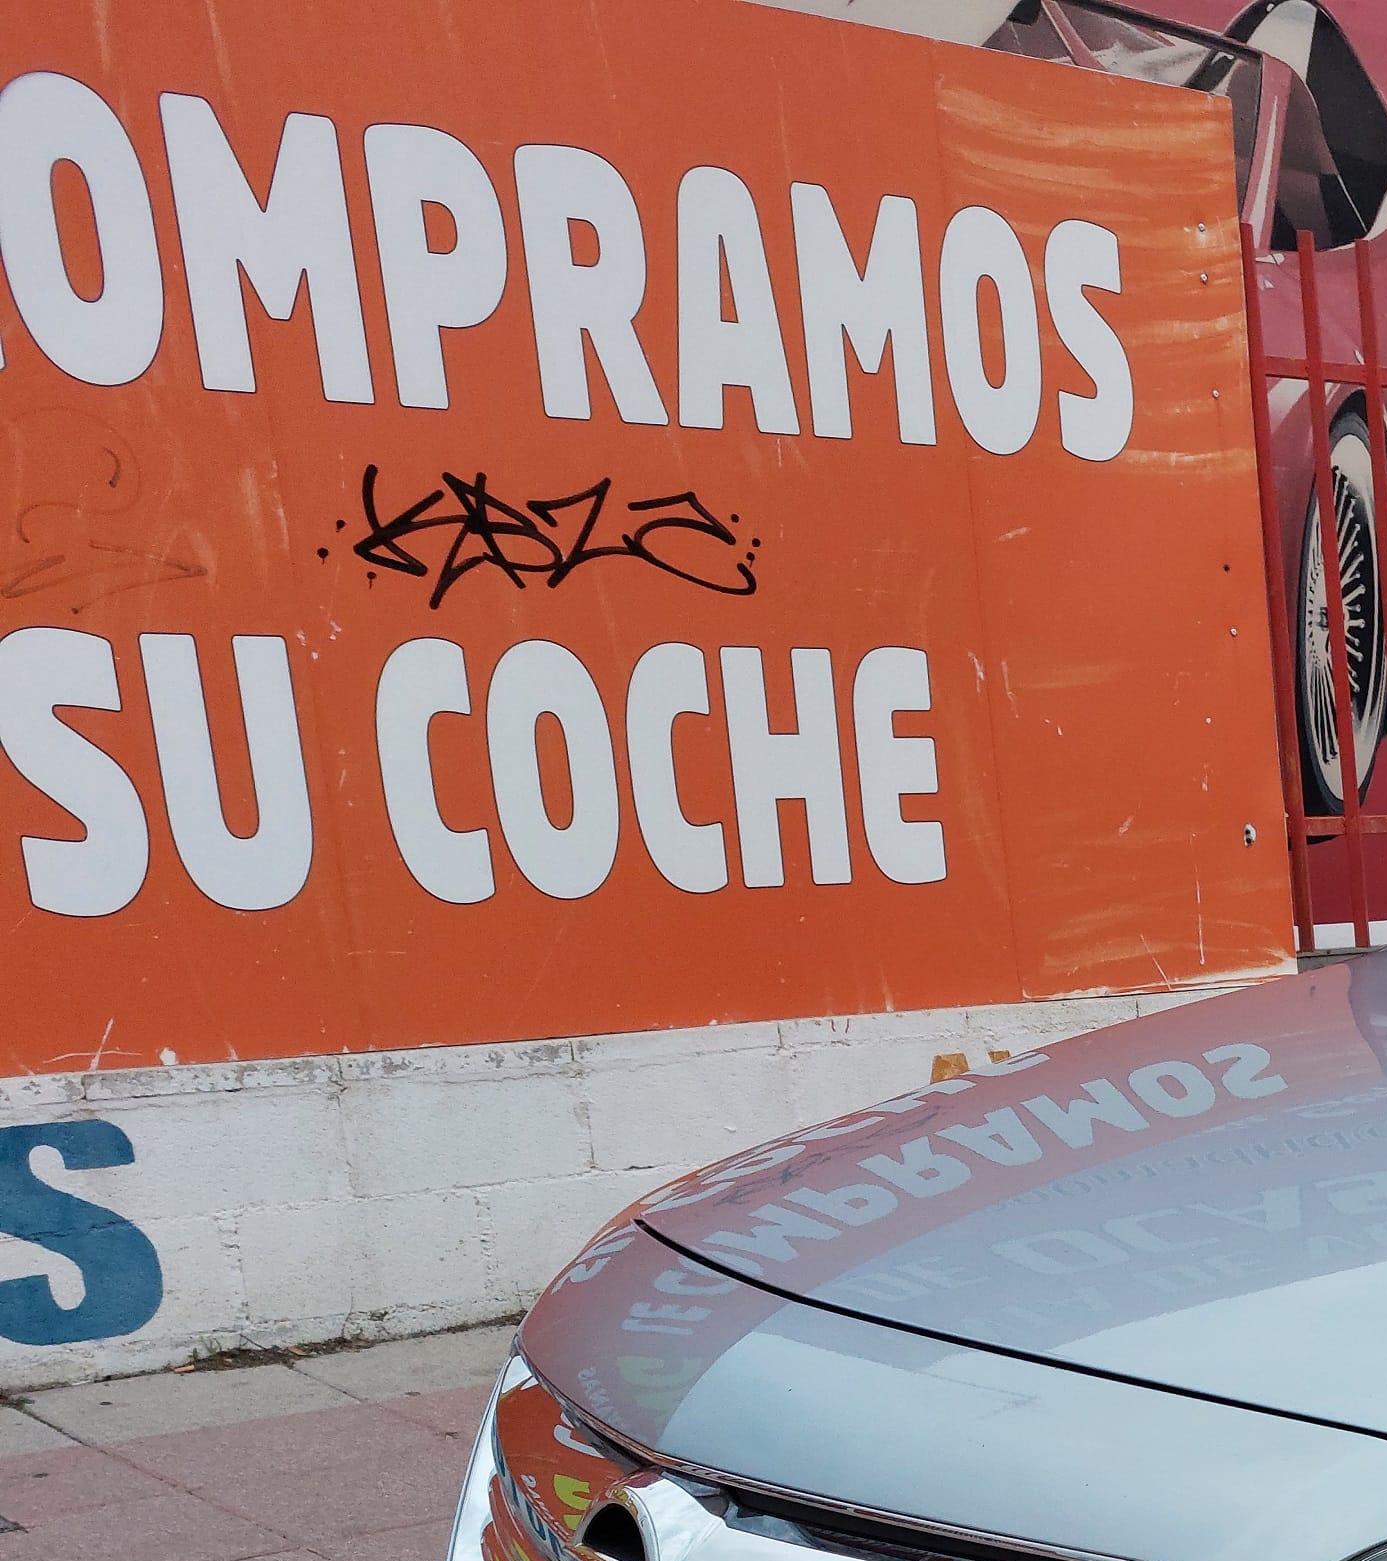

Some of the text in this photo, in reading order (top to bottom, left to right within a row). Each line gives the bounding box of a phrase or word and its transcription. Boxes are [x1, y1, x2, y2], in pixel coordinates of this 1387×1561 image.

[0, 70, 1134, 463] OMPRAMOS
[0, 625, 948, 918] SU COCHE
